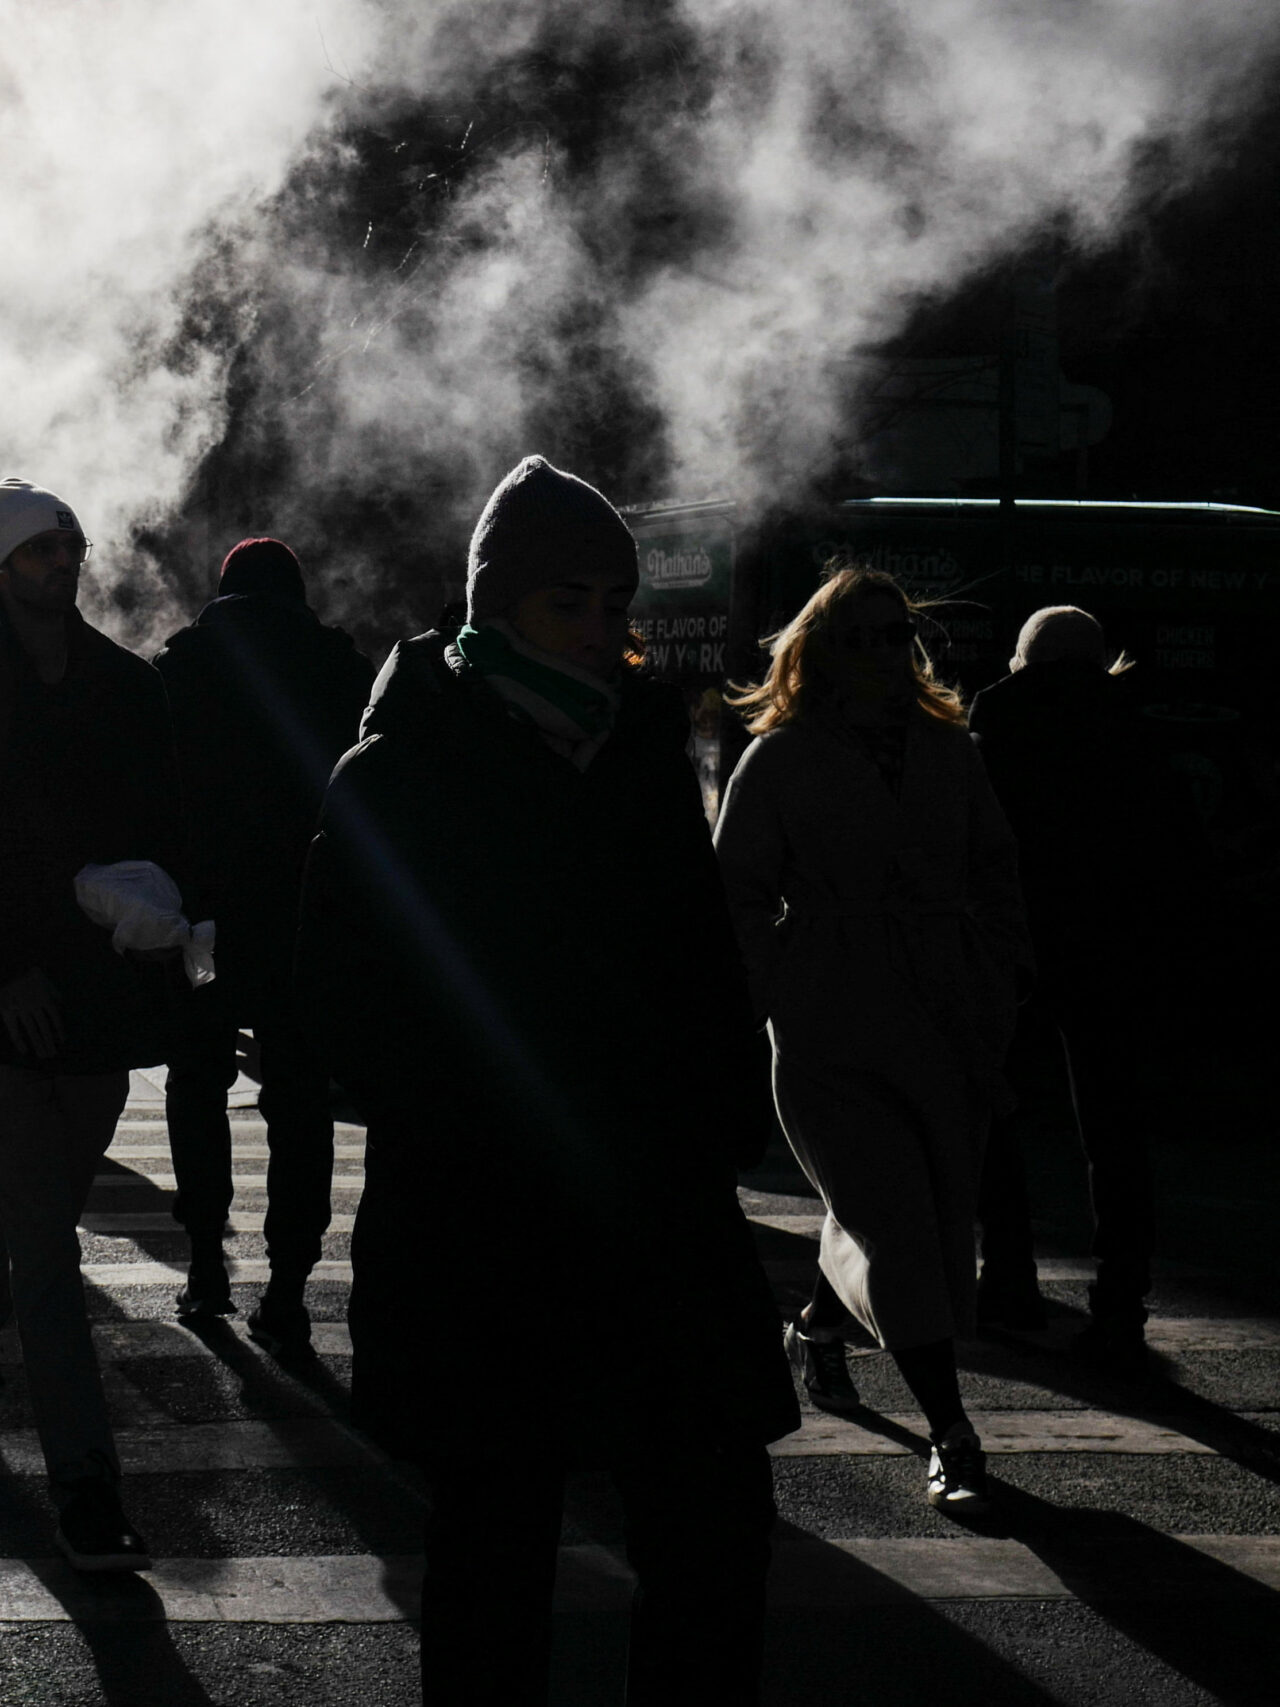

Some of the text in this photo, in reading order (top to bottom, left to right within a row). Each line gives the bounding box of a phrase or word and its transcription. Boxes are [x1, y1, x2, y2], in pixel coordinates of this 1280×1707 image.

[647, 547, 711, 581] Nathan's
[1014, 564, 1045, 584] HE
[1050, 565, 1145, 586] FLAVOR
[1151, 568, 1183, 588] OF
[1191, 570, 1246, 590] NEW
[656, 617, 706, 639] FLAVOR
[709, 615, 727, 636] OF
[675, 642, 726, 672] YRK
